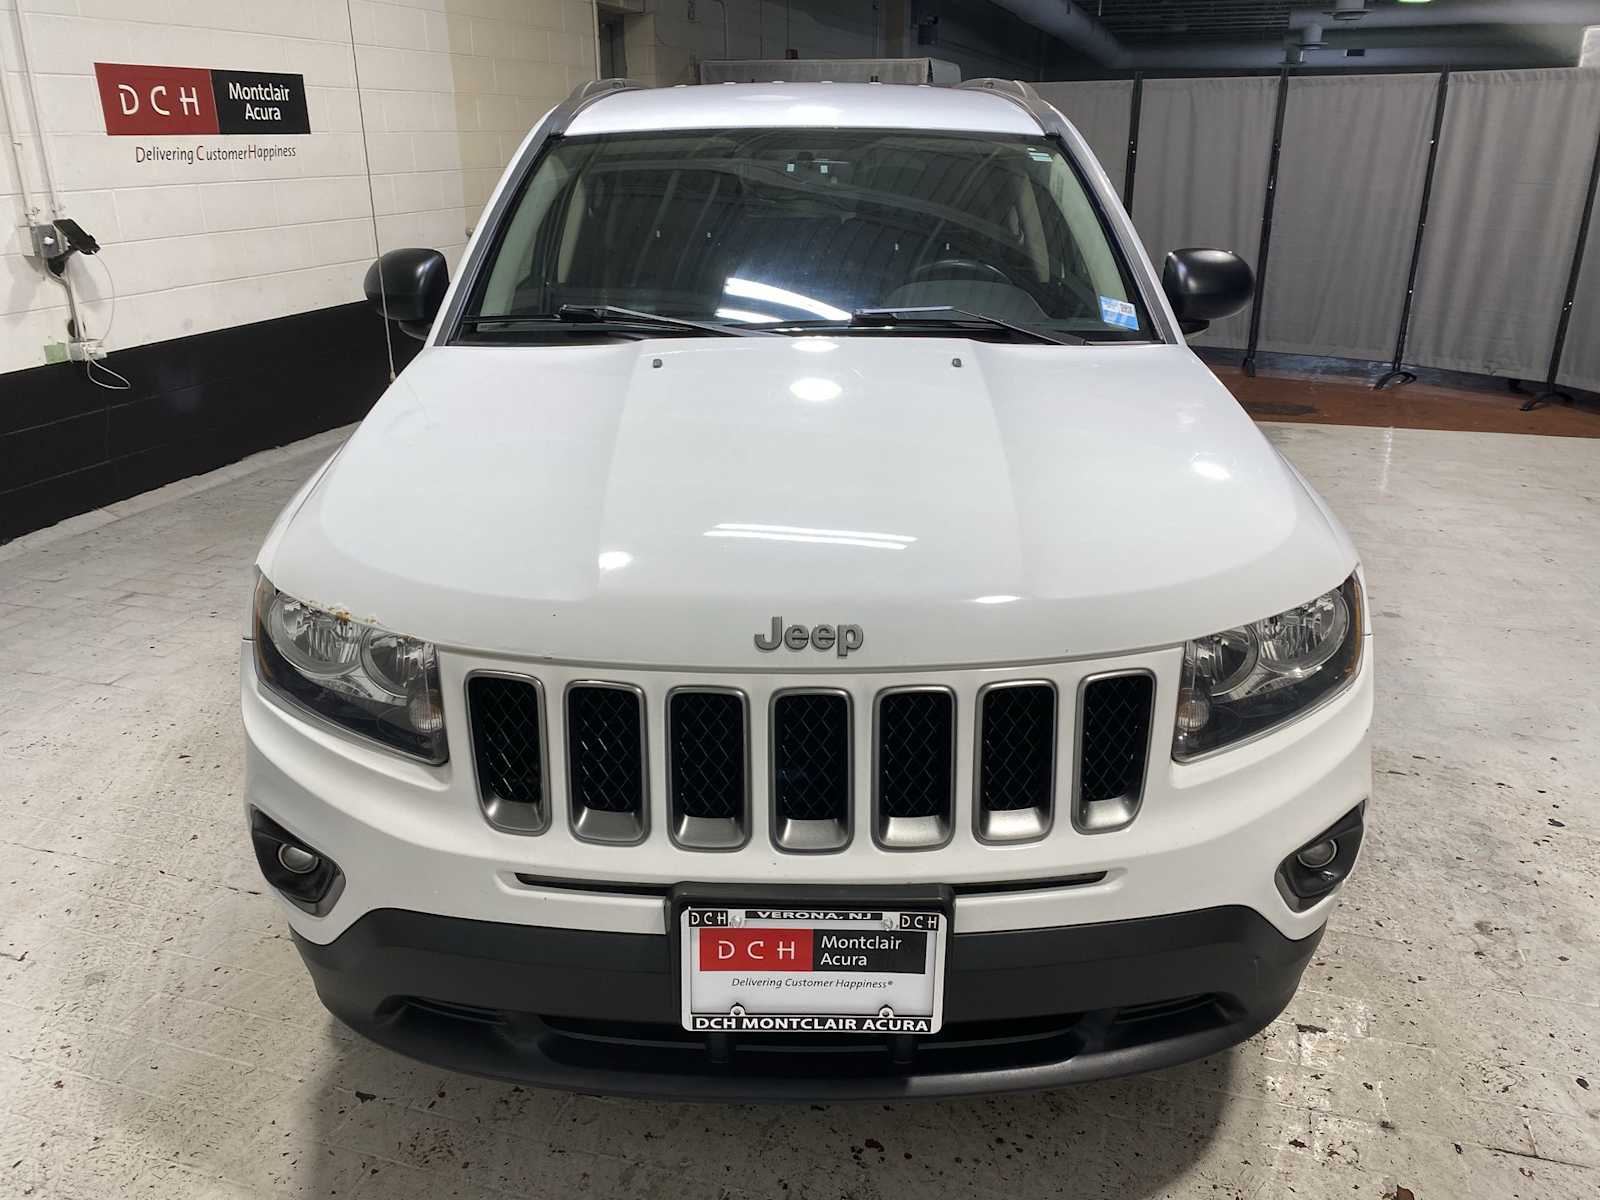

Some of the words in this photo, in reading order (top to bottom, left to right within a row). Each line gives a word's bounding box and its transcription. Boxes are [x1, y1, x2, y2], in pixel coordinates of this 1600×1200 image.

[228, 82, 290, 102] Montclair
[118, 84, 200, 116] DCH
[245, 104, 281, 121] Acura
[135, 146, 194, 165] Delivering
[196, 145, 248, 161] Customer
[248, 144, 296, 160] Happiness
[754, 616, 864, 658] Jeep
[690, 911, 727, 926] DCH
[848, 912, 872, 920] NJ
[901, 915, 937, 929] DCH
[718, 940, 795, 960] DCH
[821, 935, 902, 950] Montclair
[820, 952, 867, 966] Acura
[732, 977, 782, 988] Delivering
[785, 978, 833, 988] Customer
[695, 1017, 737, 1029] DCH
[742, 1018, 857, 1030] MONTCLAIR
[863, 1019, 929, 1031] ACURA
